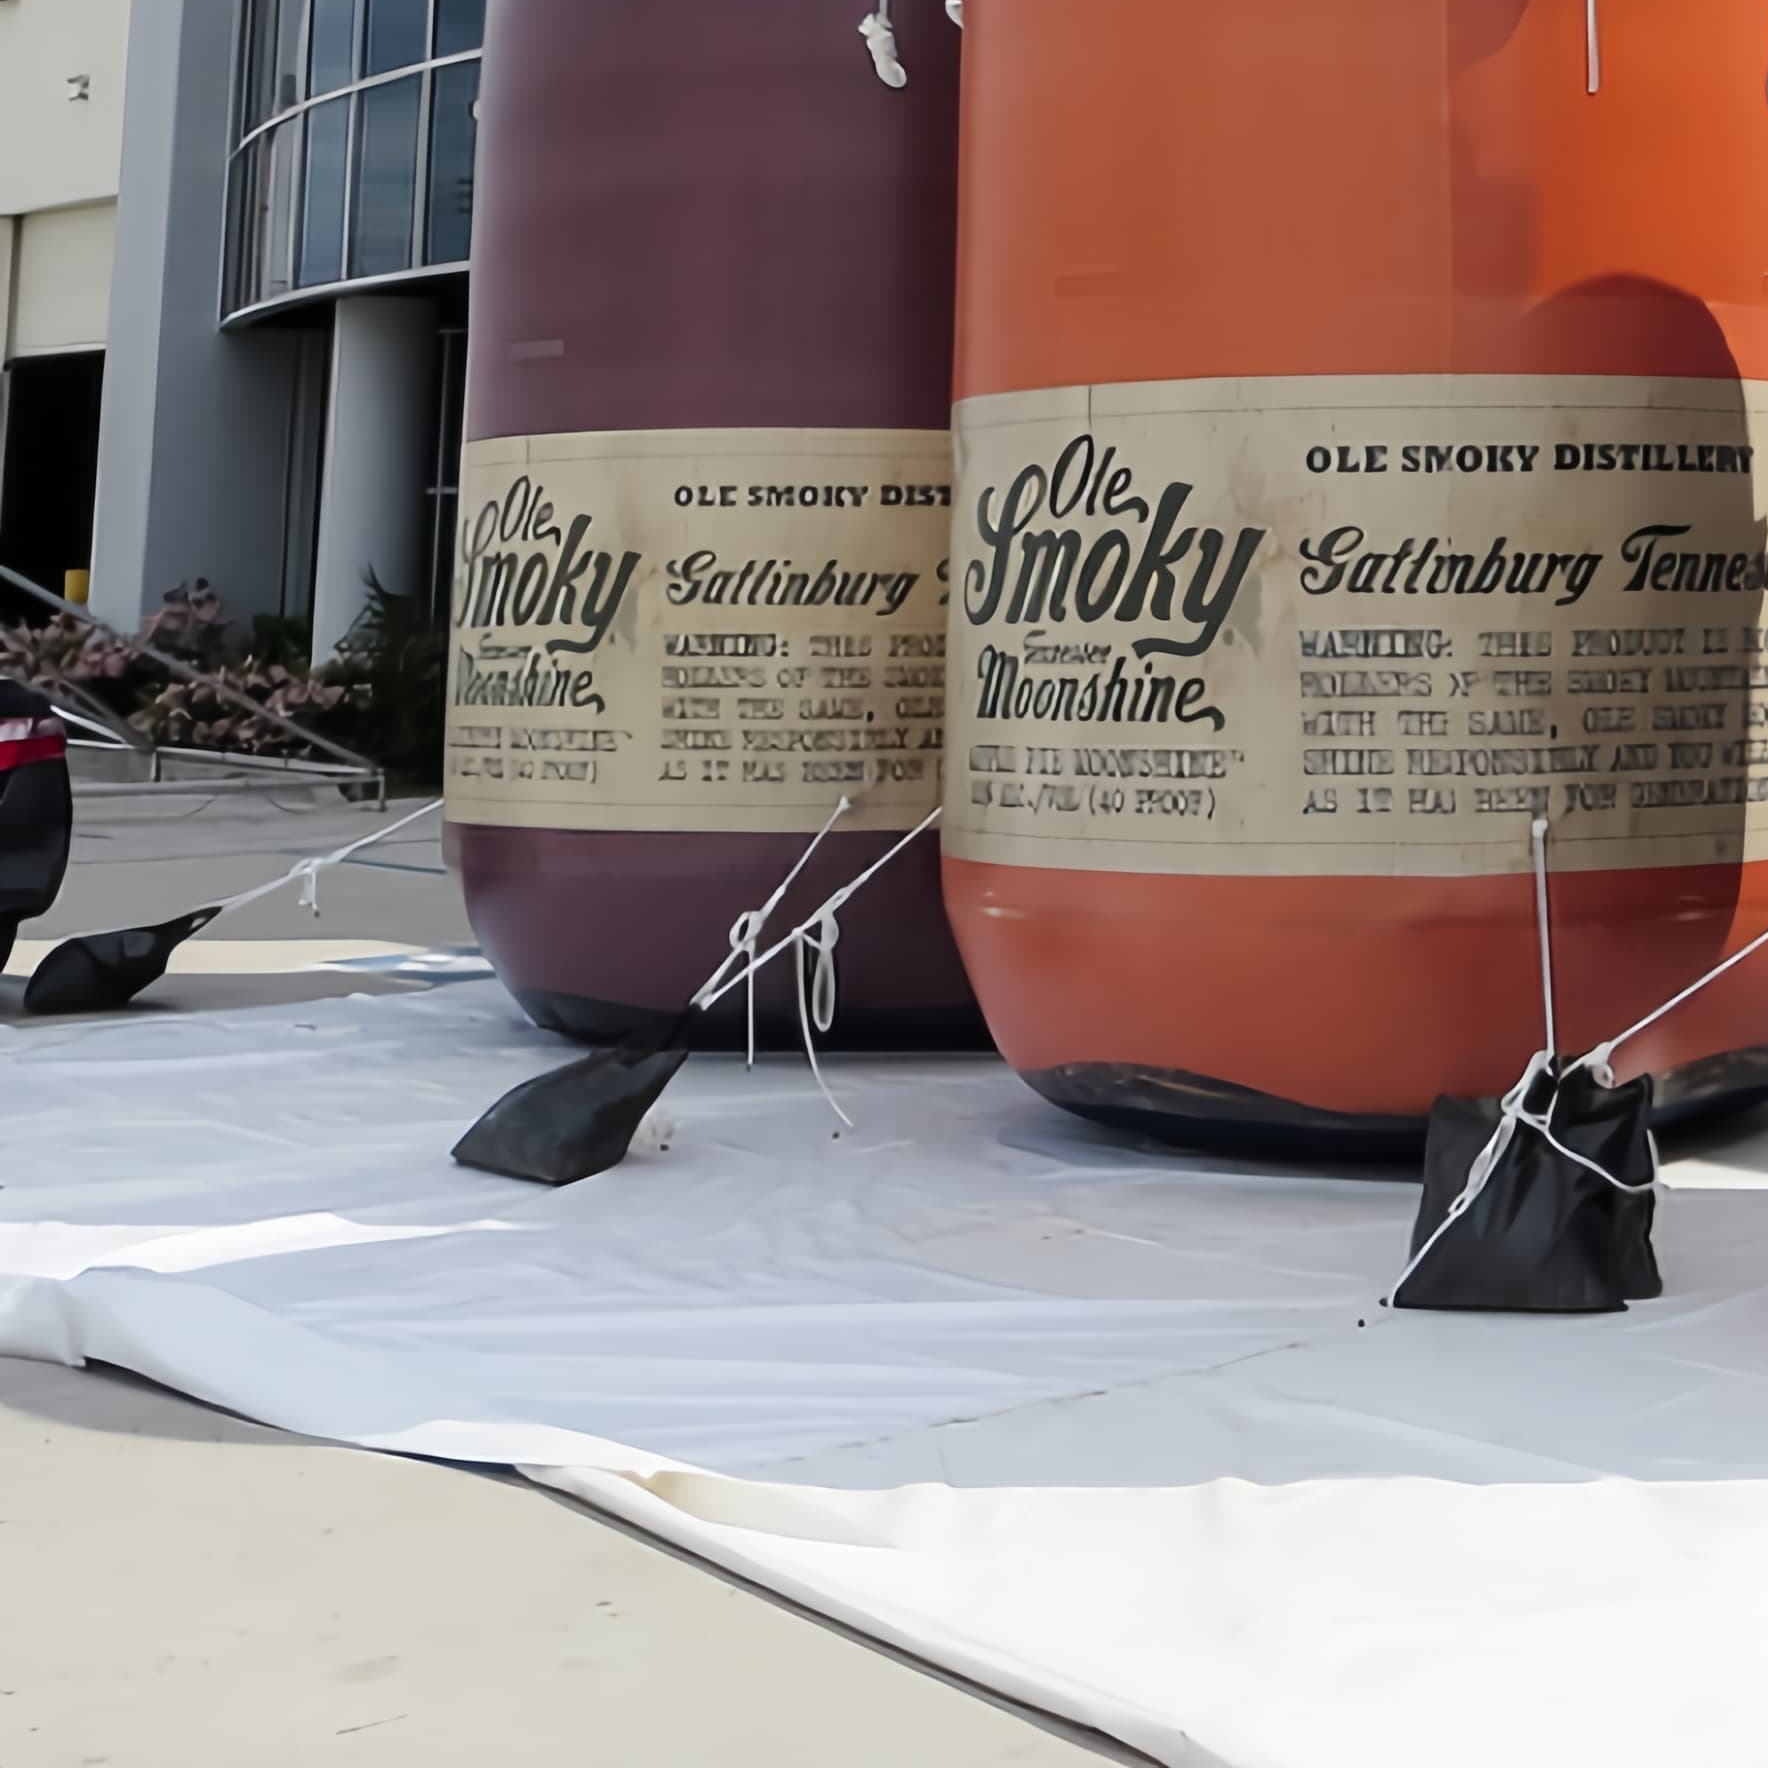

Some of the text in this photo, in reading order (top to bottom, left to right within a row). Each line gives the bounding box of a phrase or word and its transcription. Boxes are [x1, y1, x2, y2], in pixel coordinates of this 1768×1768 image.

[674, 485, 738, 507] OLE
[748, 485, 869, 507] SMOKY
[1049, 433, 1149, 523] Ole
[1306, 445, 1388, 473] OLE
[1401, 445, 1540, 473] SMOKY
[1554, 443, 1754, 474] DISTILLERY
[500, 475, 561, 546] Ole
[455, 500, 642, 655] Smoky
[666, 550, 921, 616] Gatlinburg
[964, 463, 1268, 660] Smoky
[1299, 525, 1604, 606] Gatlinburg
[976, 644, 1226, 732] Moonshine
